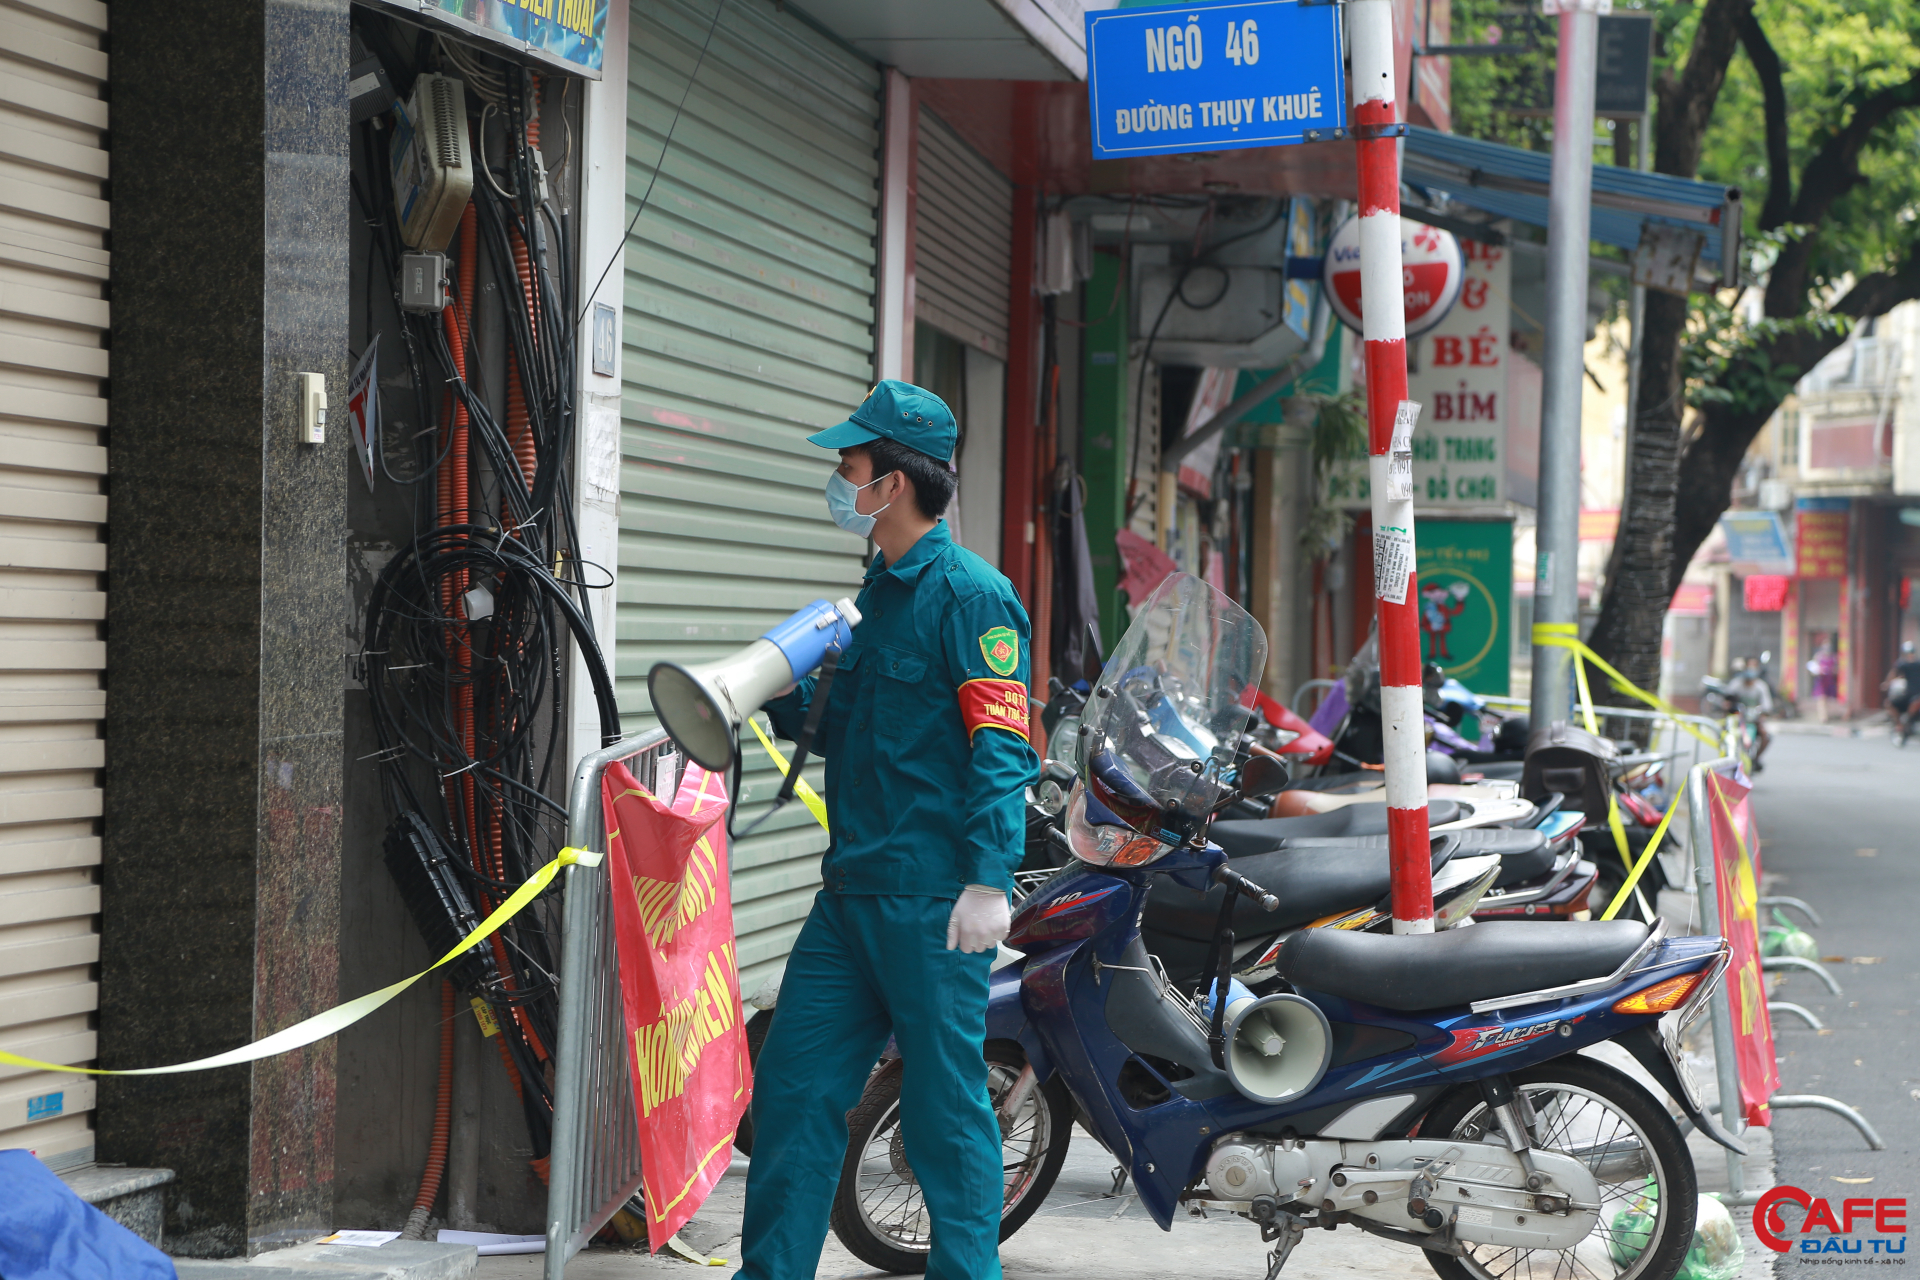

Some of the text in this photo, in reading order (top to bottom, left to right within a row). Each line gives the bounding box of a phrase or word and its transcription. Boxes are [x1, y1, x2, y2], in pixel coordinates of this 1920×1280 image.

[1145, 14, 1260, 73] NGÕ 46
[1116, 86, 1323, 134] ĐƯỜNG THỤY KHUÊ
[599, 316, 614, 363] 46
[1432, 326, 1499, 367] BÉ
[1444, 436, 1496, 462] TRANG
[1498, 1038, 1524, 1047] HONDA
